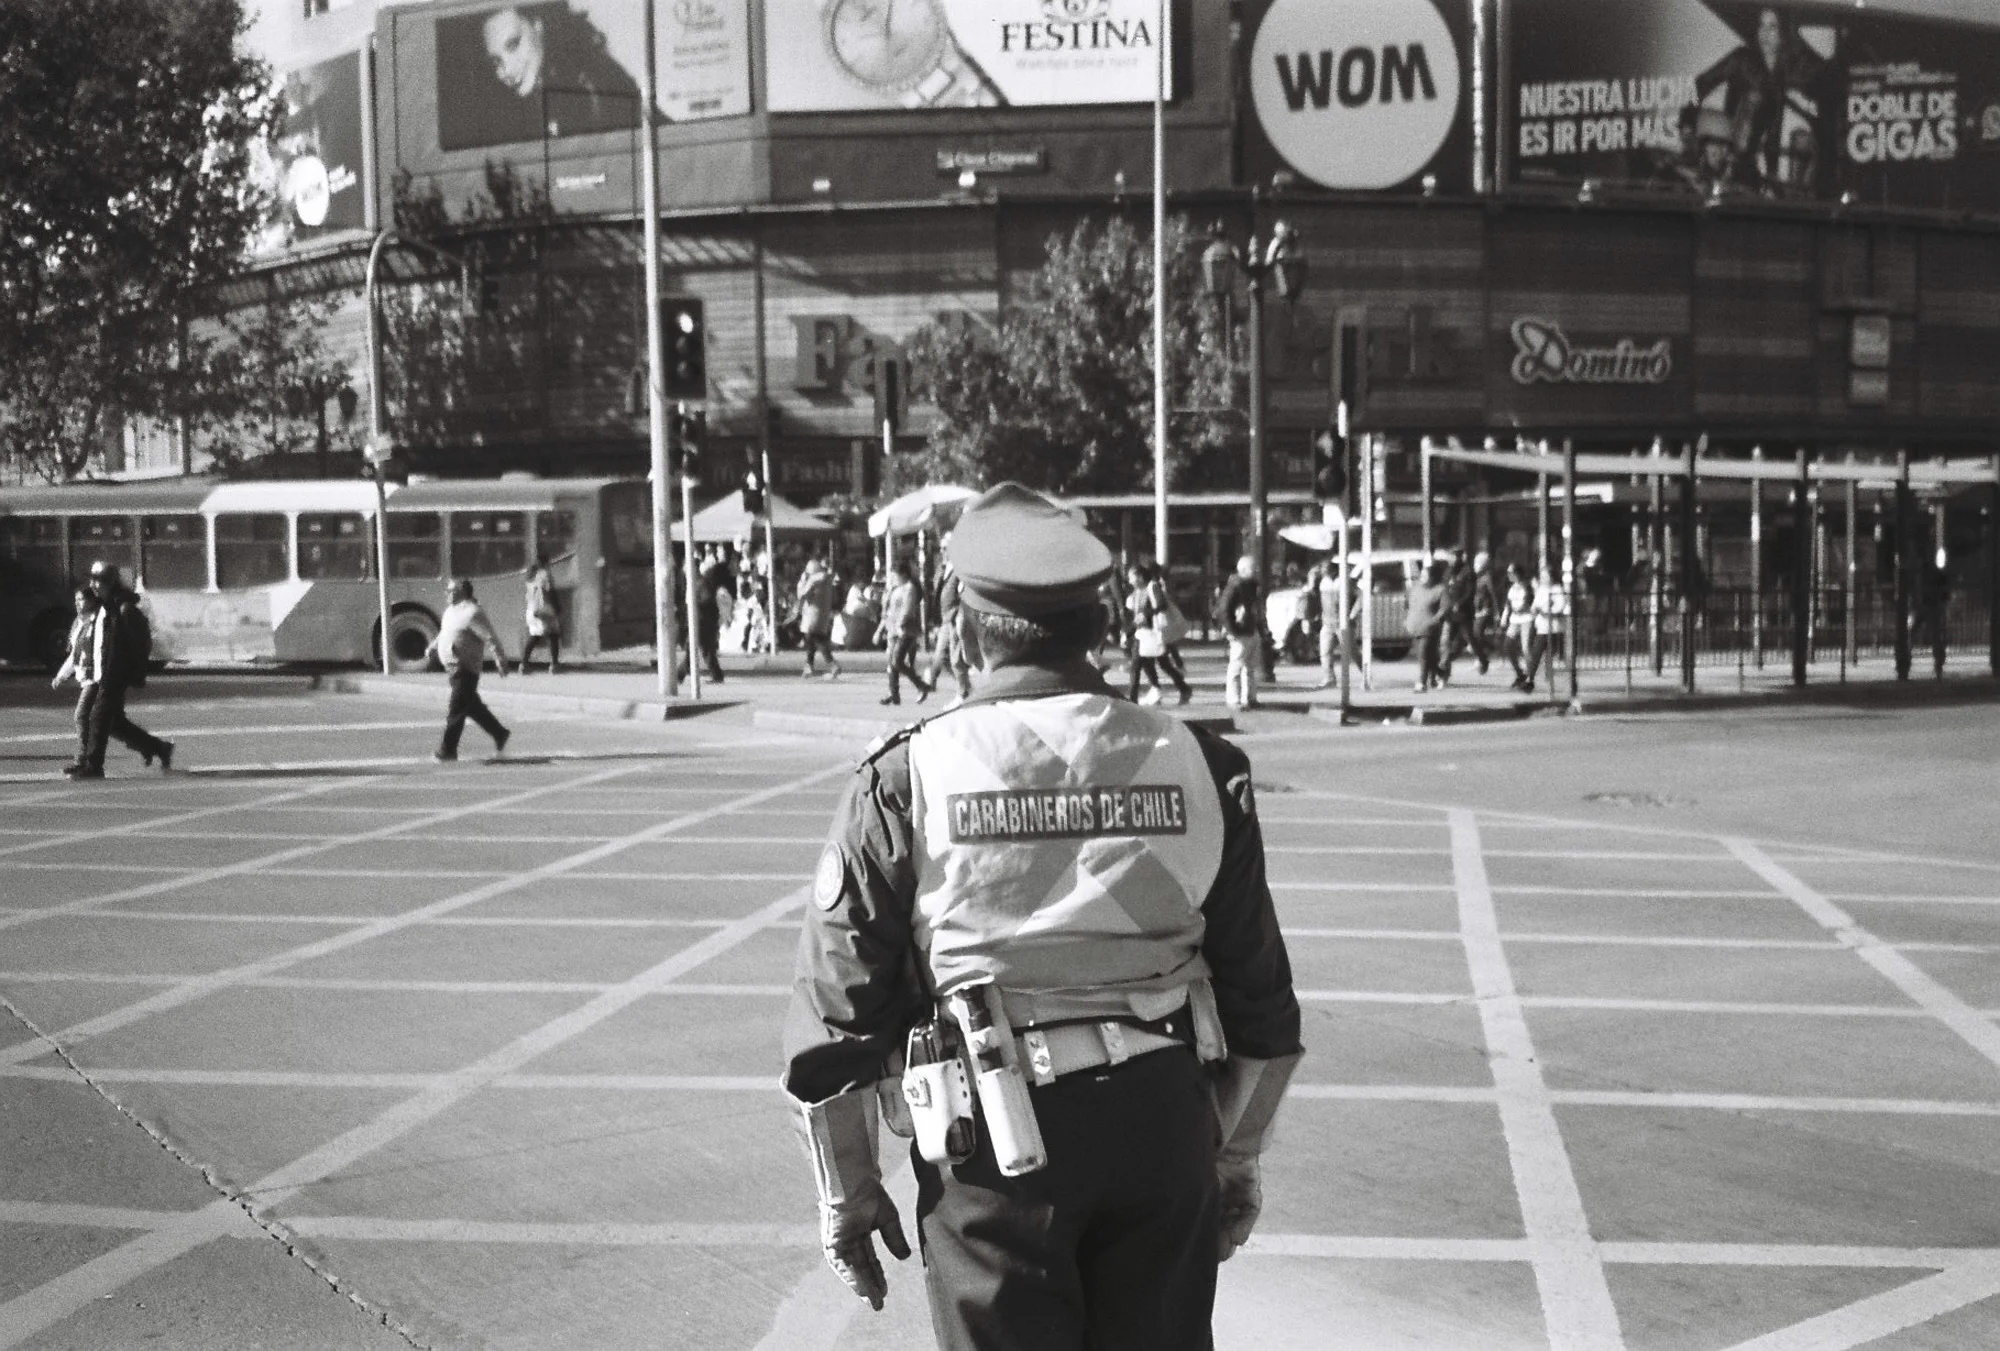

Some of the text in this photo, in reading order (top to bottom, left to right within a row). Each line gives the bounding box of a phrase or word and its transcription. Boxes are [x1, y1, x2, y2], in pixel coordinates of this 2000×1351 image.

[1001, 19, 1153, 51] FESTINA
[1274, 43, 1437, 112] WOM
[1519, 79, 1625, 117] NUESTRA
[1848, 90, 1957, 123] DOBLE DE
[1519, 122, 1549, 156] ES
[1553, 120, 1577, 155] IR
[1581, 117, 1628, 153] POR
[1847, 119, 1957, 162] GIGAS
[955, 791, 1183, 837] CARABINEROS DE CHILE
